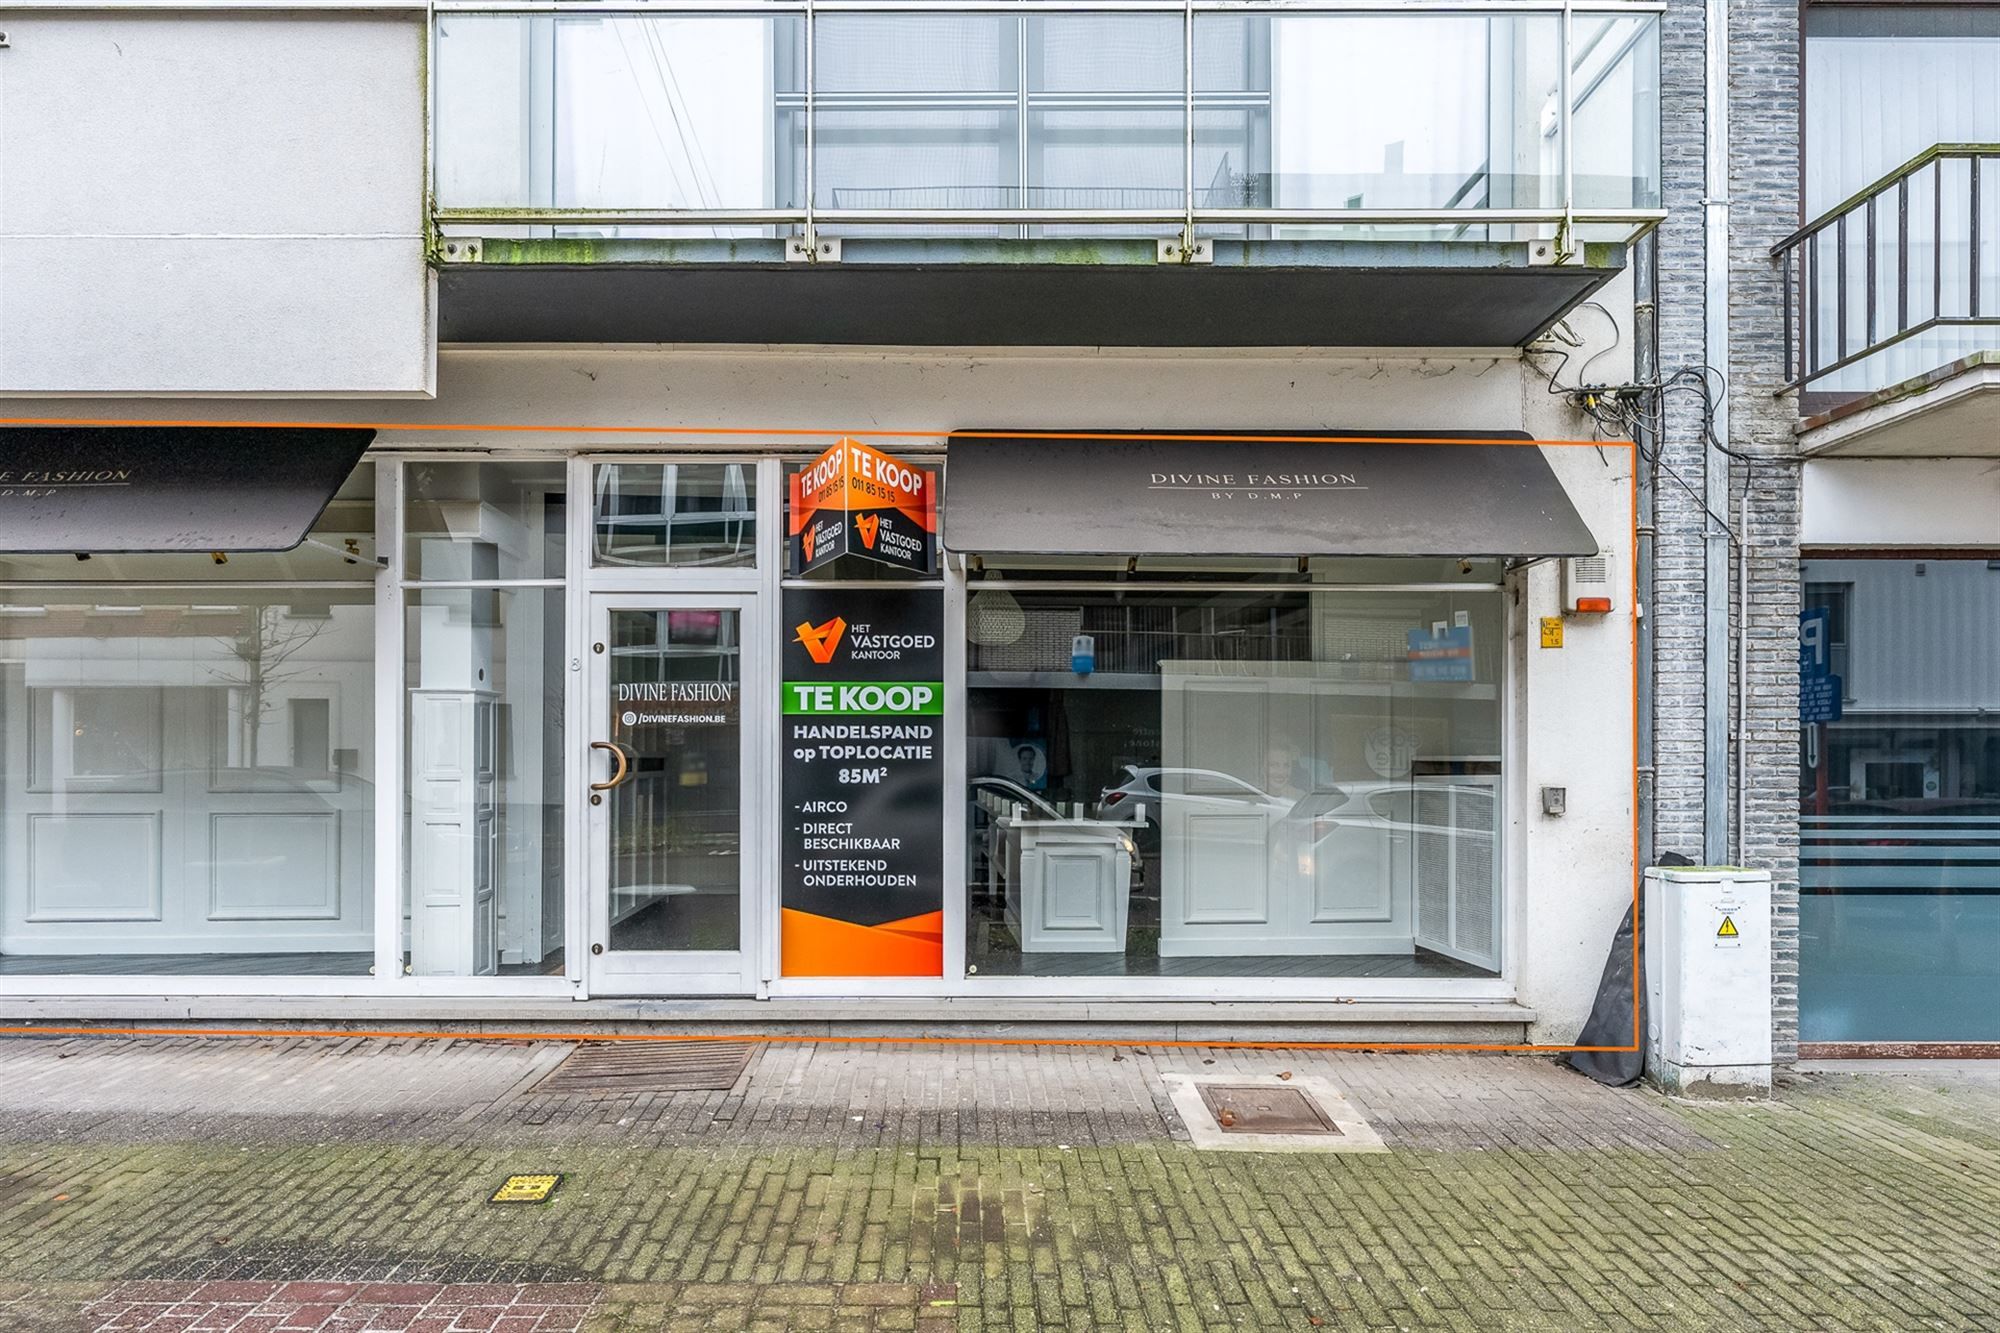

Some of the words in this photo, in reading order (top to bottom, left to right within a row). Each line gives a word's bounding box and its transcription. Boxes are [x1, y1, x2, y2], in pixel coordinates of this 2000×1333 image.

[22, 470, 131, 482] FASHION
[801, 471, 812, 498] TE
[813, 448, 843, 491] KOOP
[851, 447, 872, 478] TE
[876, 457, 923, 496] KOOP
[1151, 473, 1236, 485] DIVINE
[1248, 473, 1356, 485] FASHION
[826, 484, 832, 498] 85
[838, 476, 844, 489] 15
[852, 476, 864, 491] 011
[865, 482, 876, 496] 85
[878, 487, 886, 499] 15
[887, 490, 895, 503] 15
[1211, 492, 1233, 500] BY
[816, 520, 824, 532] HET
[880, 517, 893, 529] HET
[815, 521, 843, 546] VASTGOED
[879, 530, 922, 551] VASTGOED
[816, 540, 835, 558] KANTOOR
[880, 544, 912, 561] KANTOOR
[851, 624, 871, 633] HET
[851, 635, 935, 649] VASTGOED
[851, 650, 901, 660] KANTOOR
[619, 683, 667, 701] DIVINE
[671, 683, 732, 701] FASHION
[793, 686, 834, 711] TE
[839, 685, 933, 711] KOOP
[793, 725, 933, 739] HANDELSPAND
[793, 748, 816, 762] op
[819, 745, 932, 759] TOPLOCATIE
[838, 767, 888, 784] 85M²
[802, 801, 848, 813] AIRCO
[803, 823, 853, 834] DIRECT
[804, 838, 900, 849] BESCHIKBAAR
[803, 859, 887, 871] UITSTEKEND
[803, 875, 917, 887] ONDERHOUDEN
